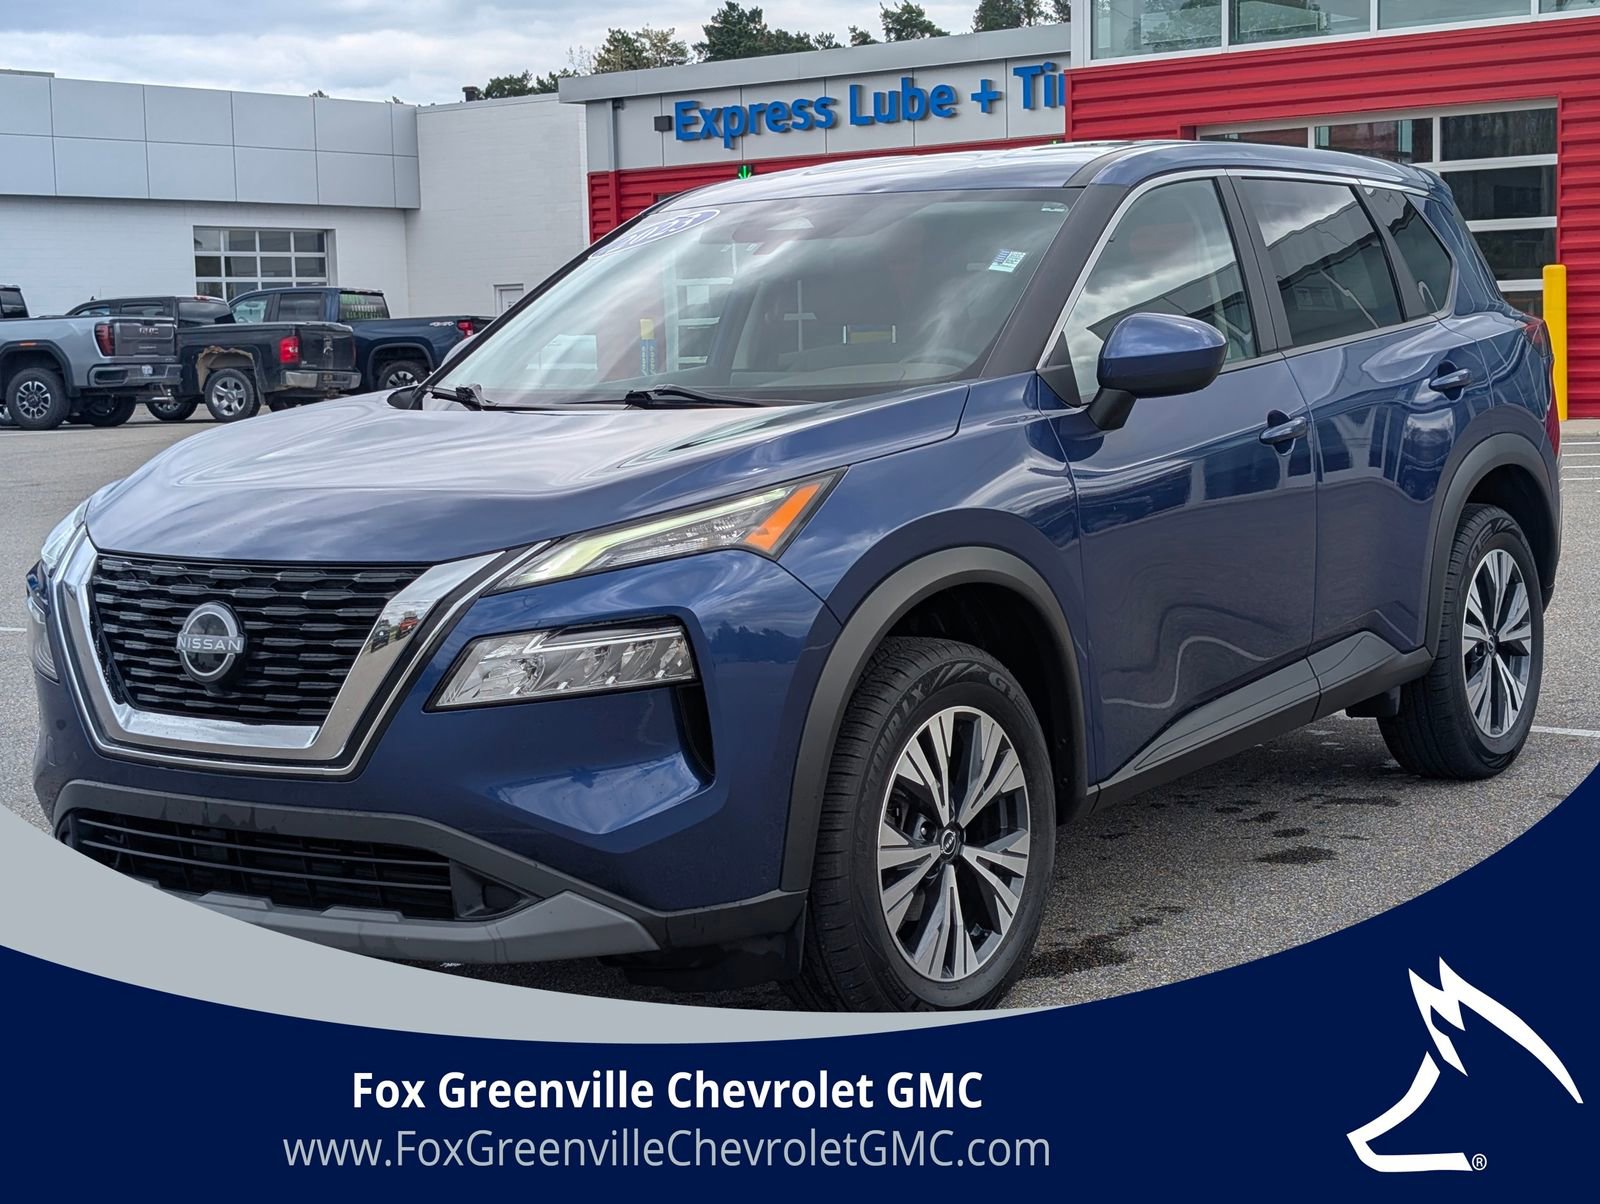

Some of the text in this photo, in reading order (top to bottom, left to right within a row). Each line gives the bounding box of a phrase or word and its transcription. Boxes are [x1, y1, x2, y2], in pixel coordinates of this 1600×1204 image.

[675, 97, 838, 150] Express
[850, 77, 957, 125] Lube
[177, 637, 240, 651] NISSAN
